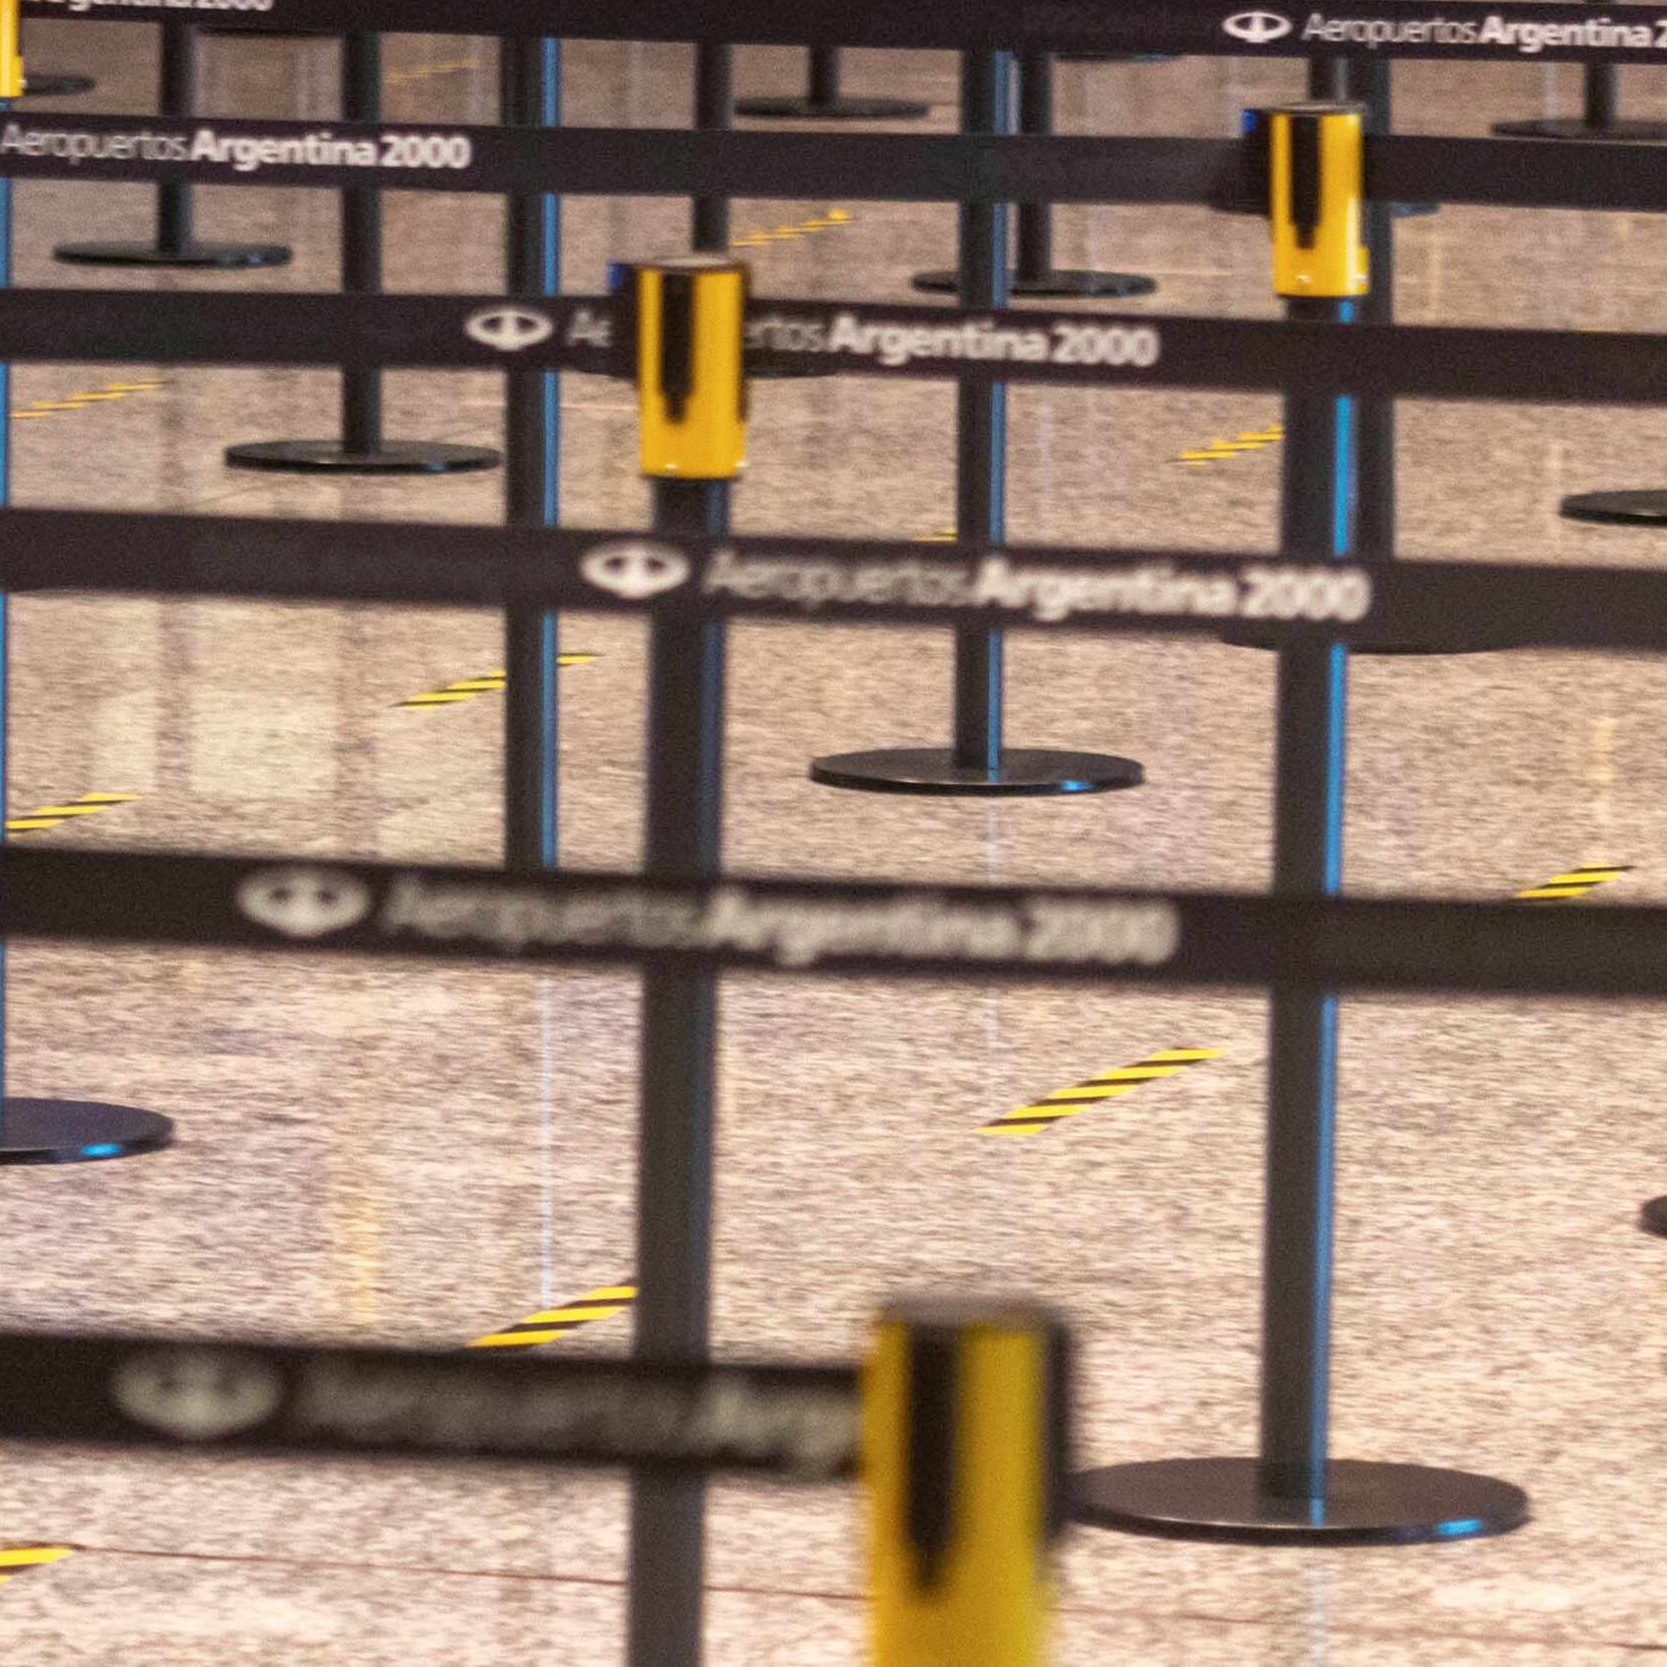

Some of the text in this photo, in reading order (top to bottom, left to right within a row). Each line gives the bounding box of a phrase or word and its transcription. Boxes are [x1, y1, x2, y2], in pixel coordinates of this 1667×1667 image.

[1301, 12, 1655, 54] Aeropuertos Argentina
[189, 127, 380, 172] Argentina
[378, 133, 474, 169] 2000
[828, 313, 1055, 367] Argentina
[1053, 322, 1161, 367] 2000
[1239, 565, 1372, 624] 2000
